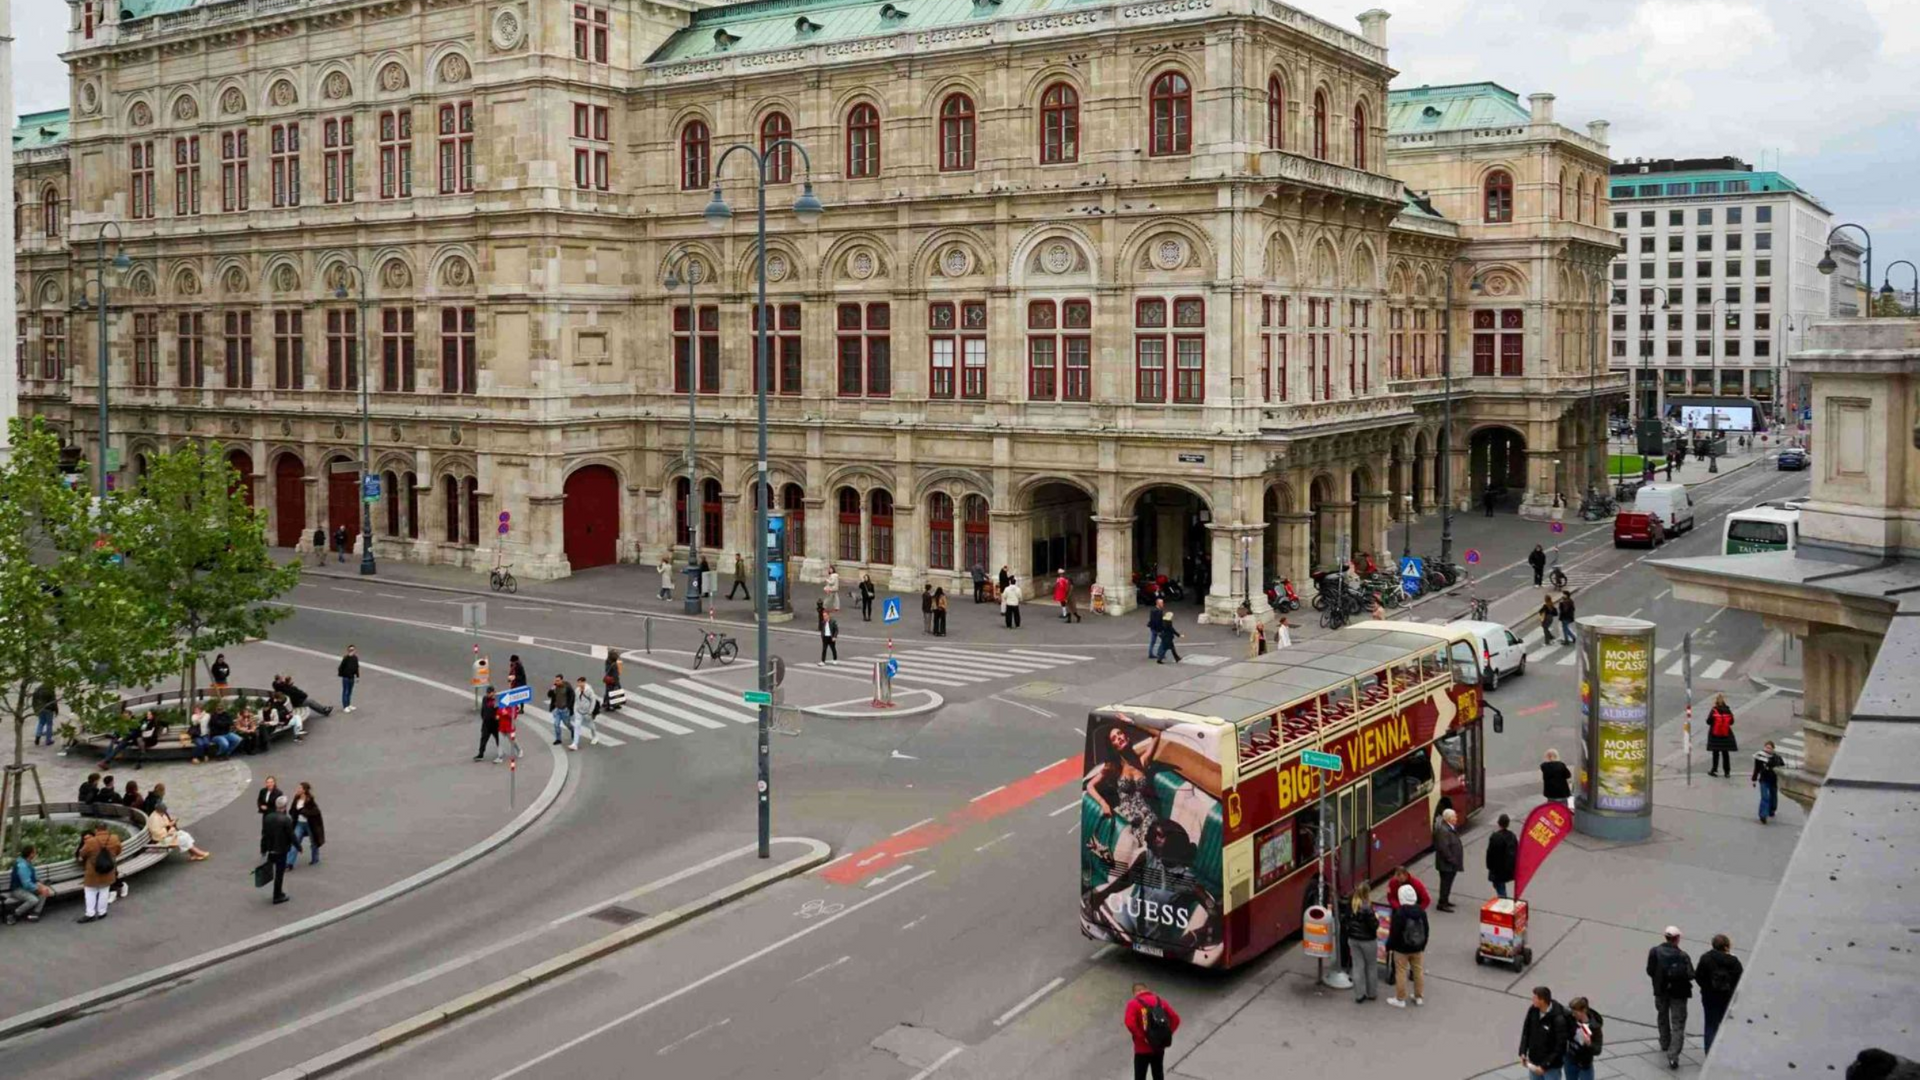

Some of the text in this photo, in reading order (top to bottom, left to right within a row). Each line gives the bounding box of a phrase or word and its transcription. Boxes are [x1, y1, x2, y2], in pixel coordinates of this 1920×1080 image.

[1604, 660, 1647, 671] PICASSO
[1347, 715, 1411, 772] VIENNA
[1108, 893, 1189, 929] GUESS
